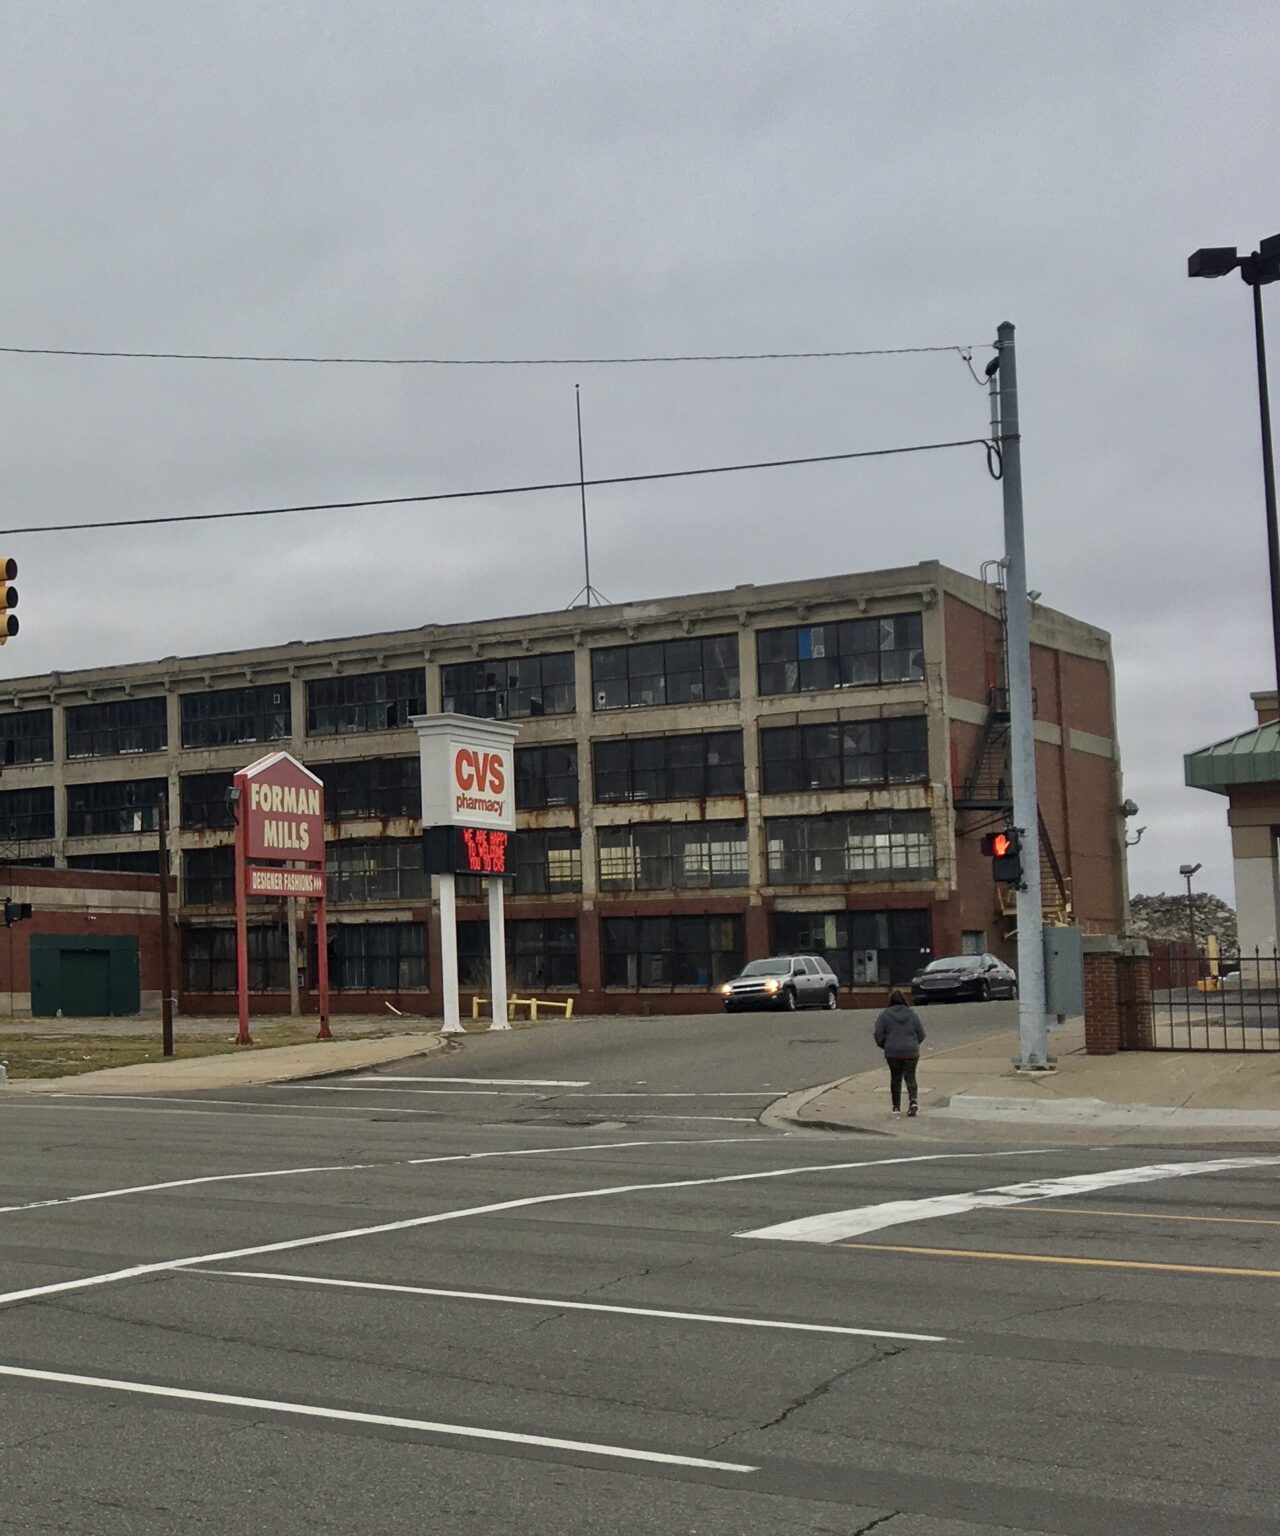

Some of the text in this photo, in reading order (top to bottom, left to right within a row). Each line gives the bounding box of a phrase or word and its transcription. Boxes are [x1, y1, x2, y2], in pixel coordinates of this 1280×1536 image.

[455, 748, 505, 795] CVS
[250, 783, 320, 816] FORMAN
[456, 792, 504, 817] pharmacy
[263, 819, 310, 851] MILLS
[469, 856, 481, 870] YOU
[252, 871, 313, 892] DESIGNER FASHIONS
